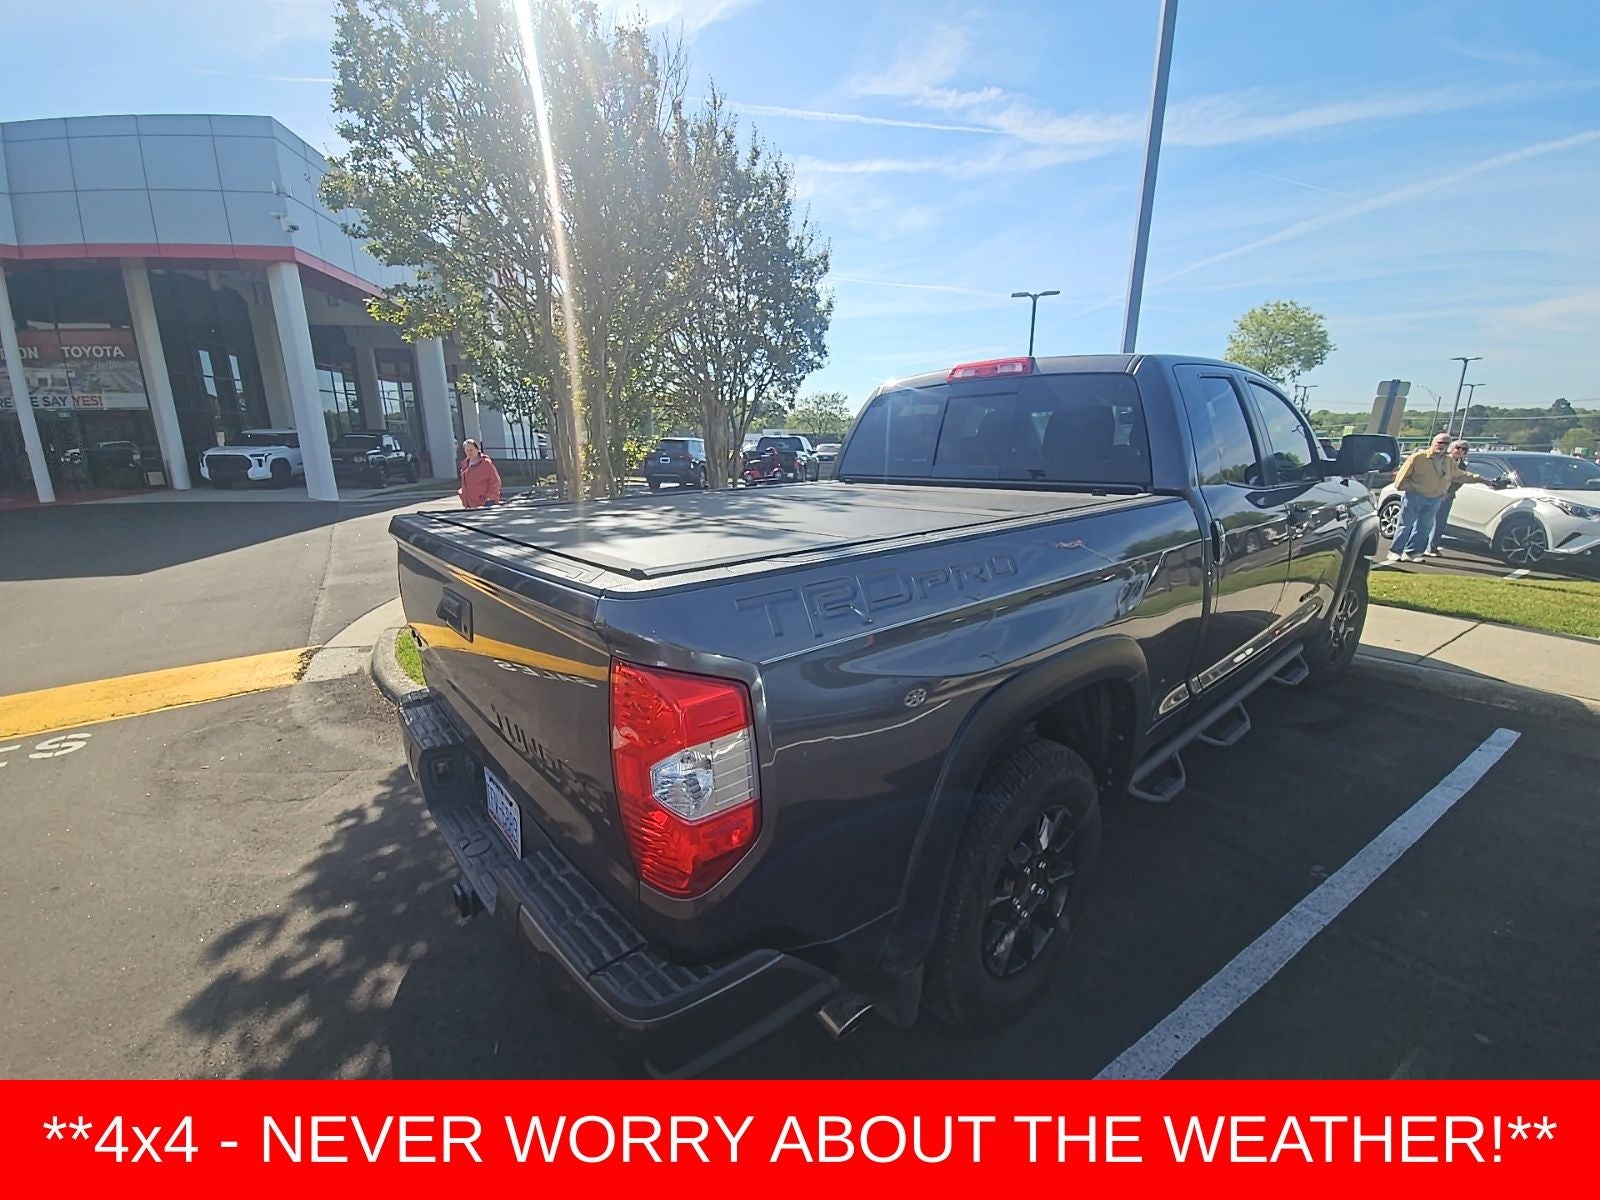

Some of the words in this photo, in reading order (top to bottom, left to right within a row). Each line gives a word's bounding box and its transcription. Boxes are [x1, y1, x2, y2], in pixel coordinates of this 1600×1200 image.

[60, 345, 125, 359] TOYOTA
[42, 396, 67, 408] SAY
[71, 395, 104, 407] YES!
[734, 567, 912, 638] TRD
[912, 552, 1020, 599] PRO
